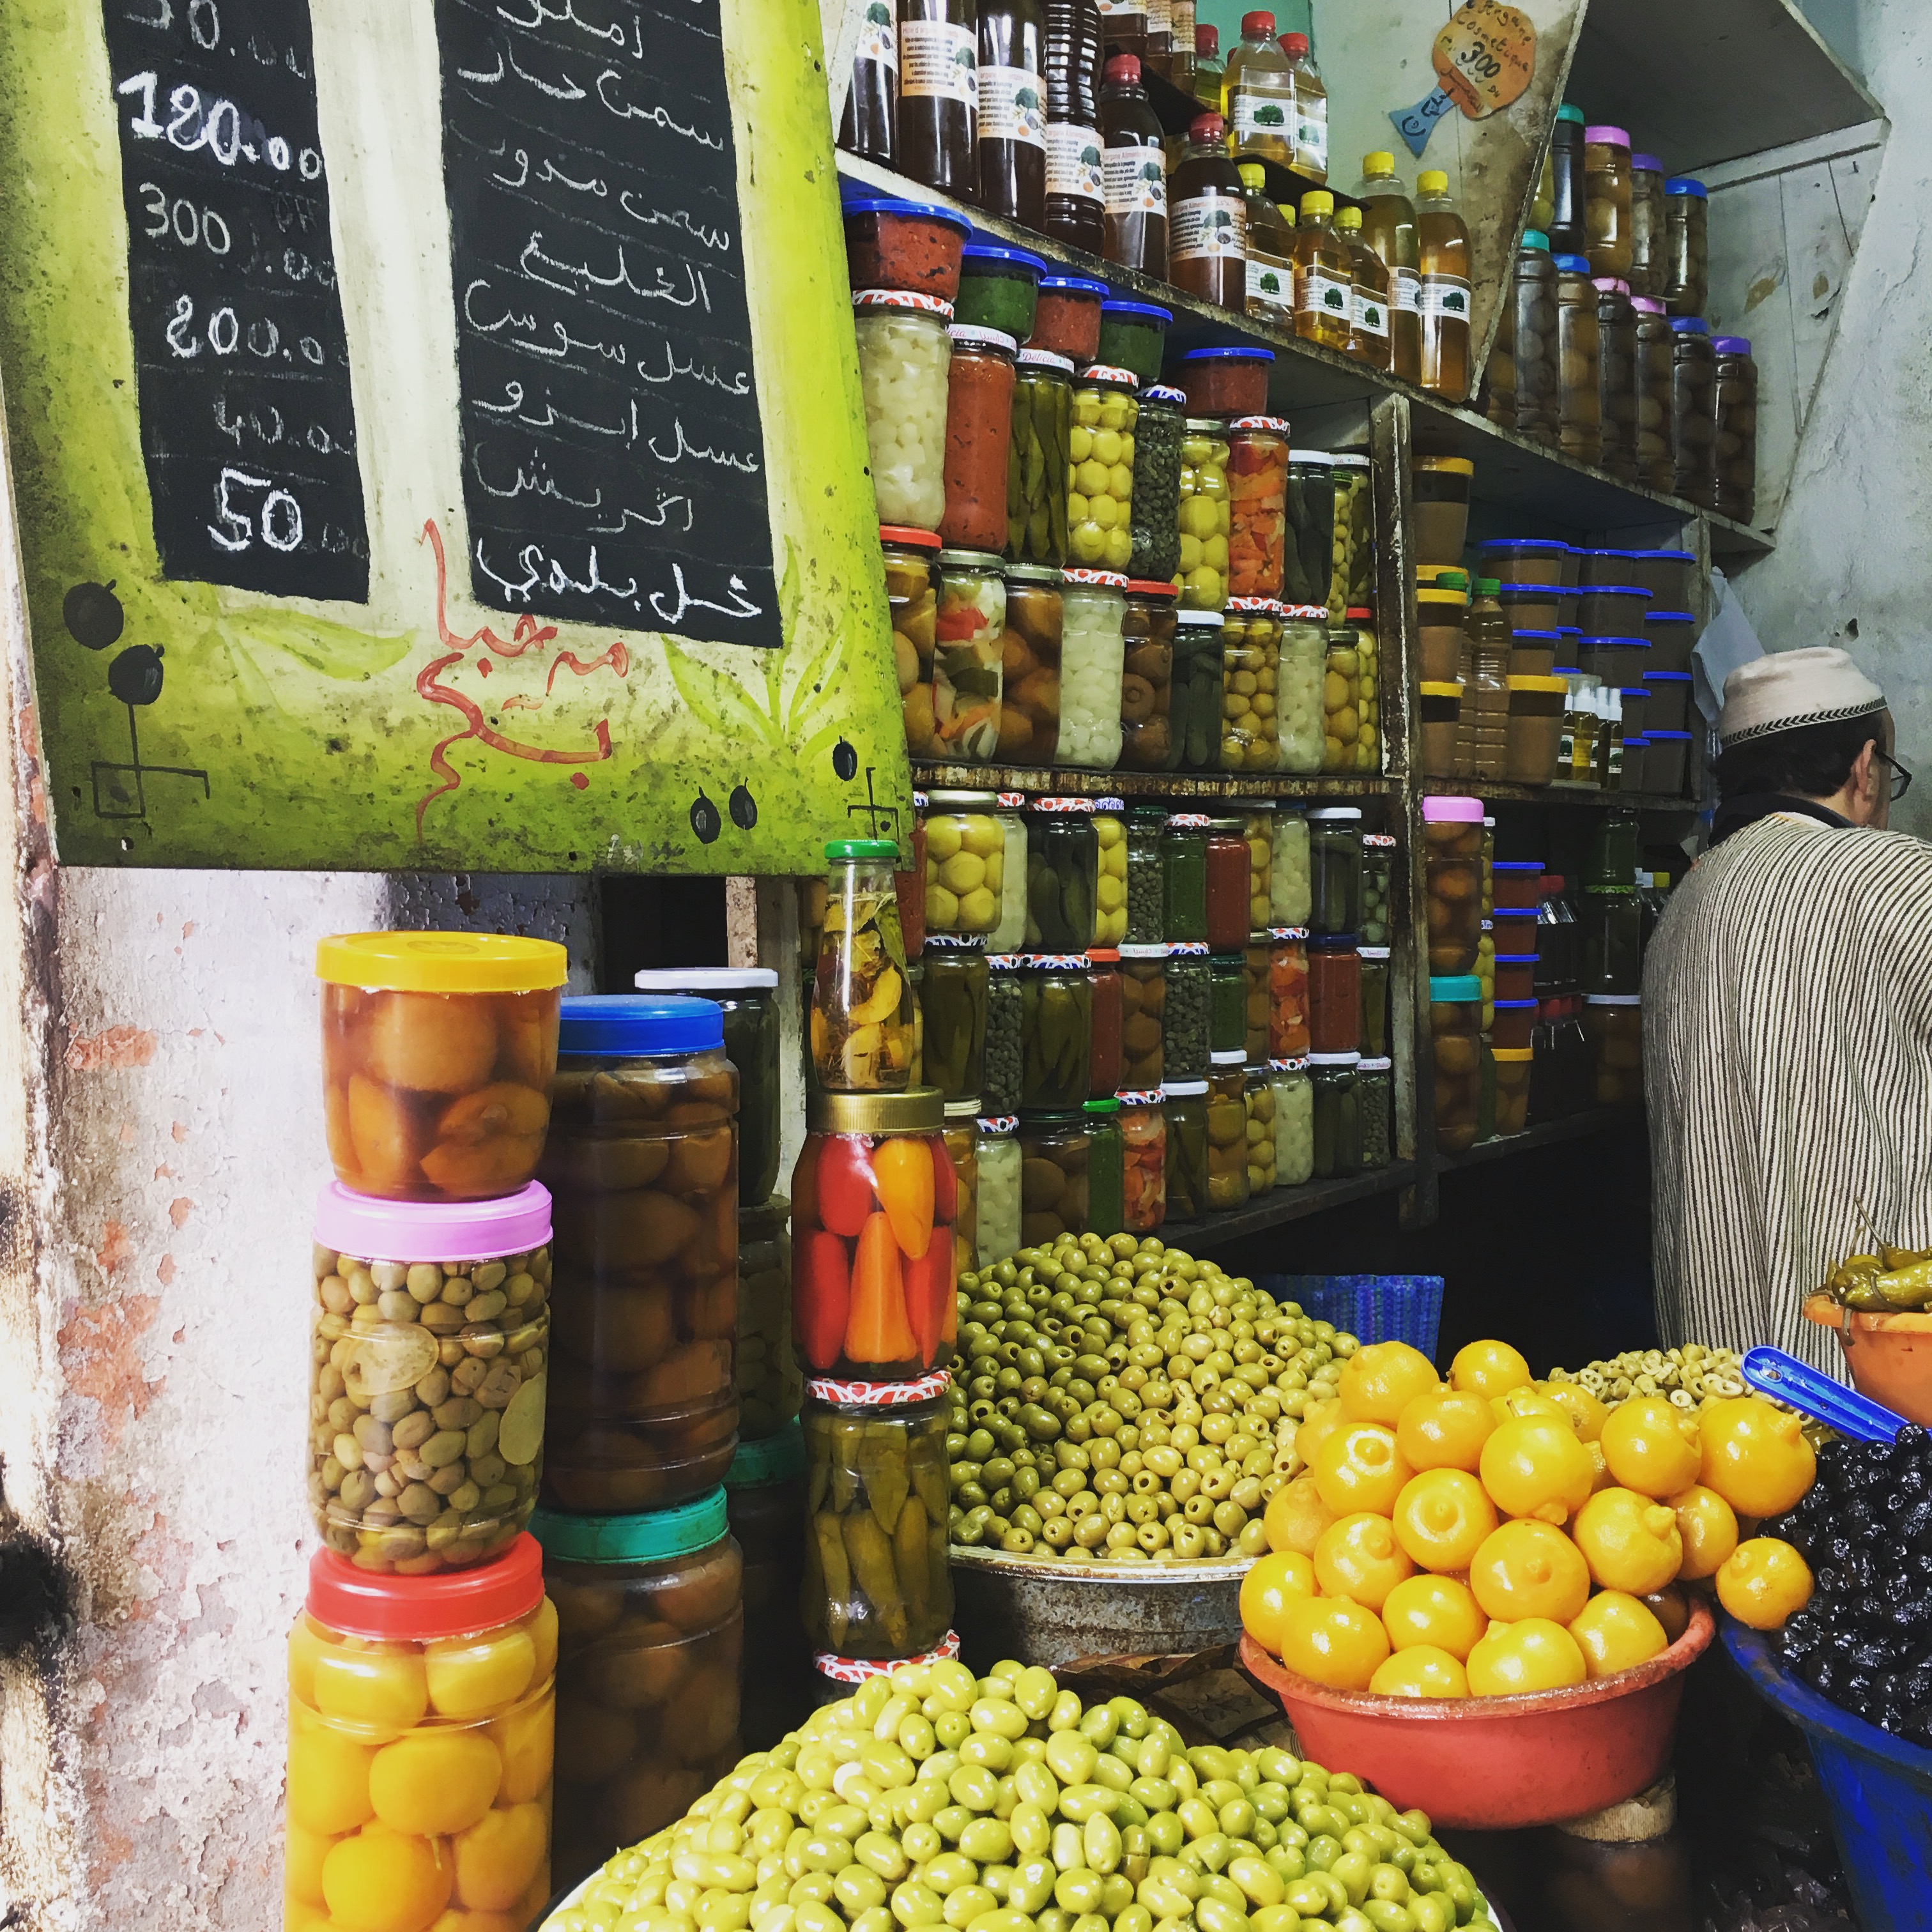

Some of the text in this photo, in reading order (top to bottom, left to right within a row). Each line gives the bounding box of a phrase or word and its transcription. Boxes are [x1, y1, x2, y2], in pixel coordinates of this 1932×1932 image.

[1460, 41, 1501, 78] 300
[638, 341, 750, 394] عسل
[648, 417, 760, 473] عسل
[650, 563, 762, 624] خل
